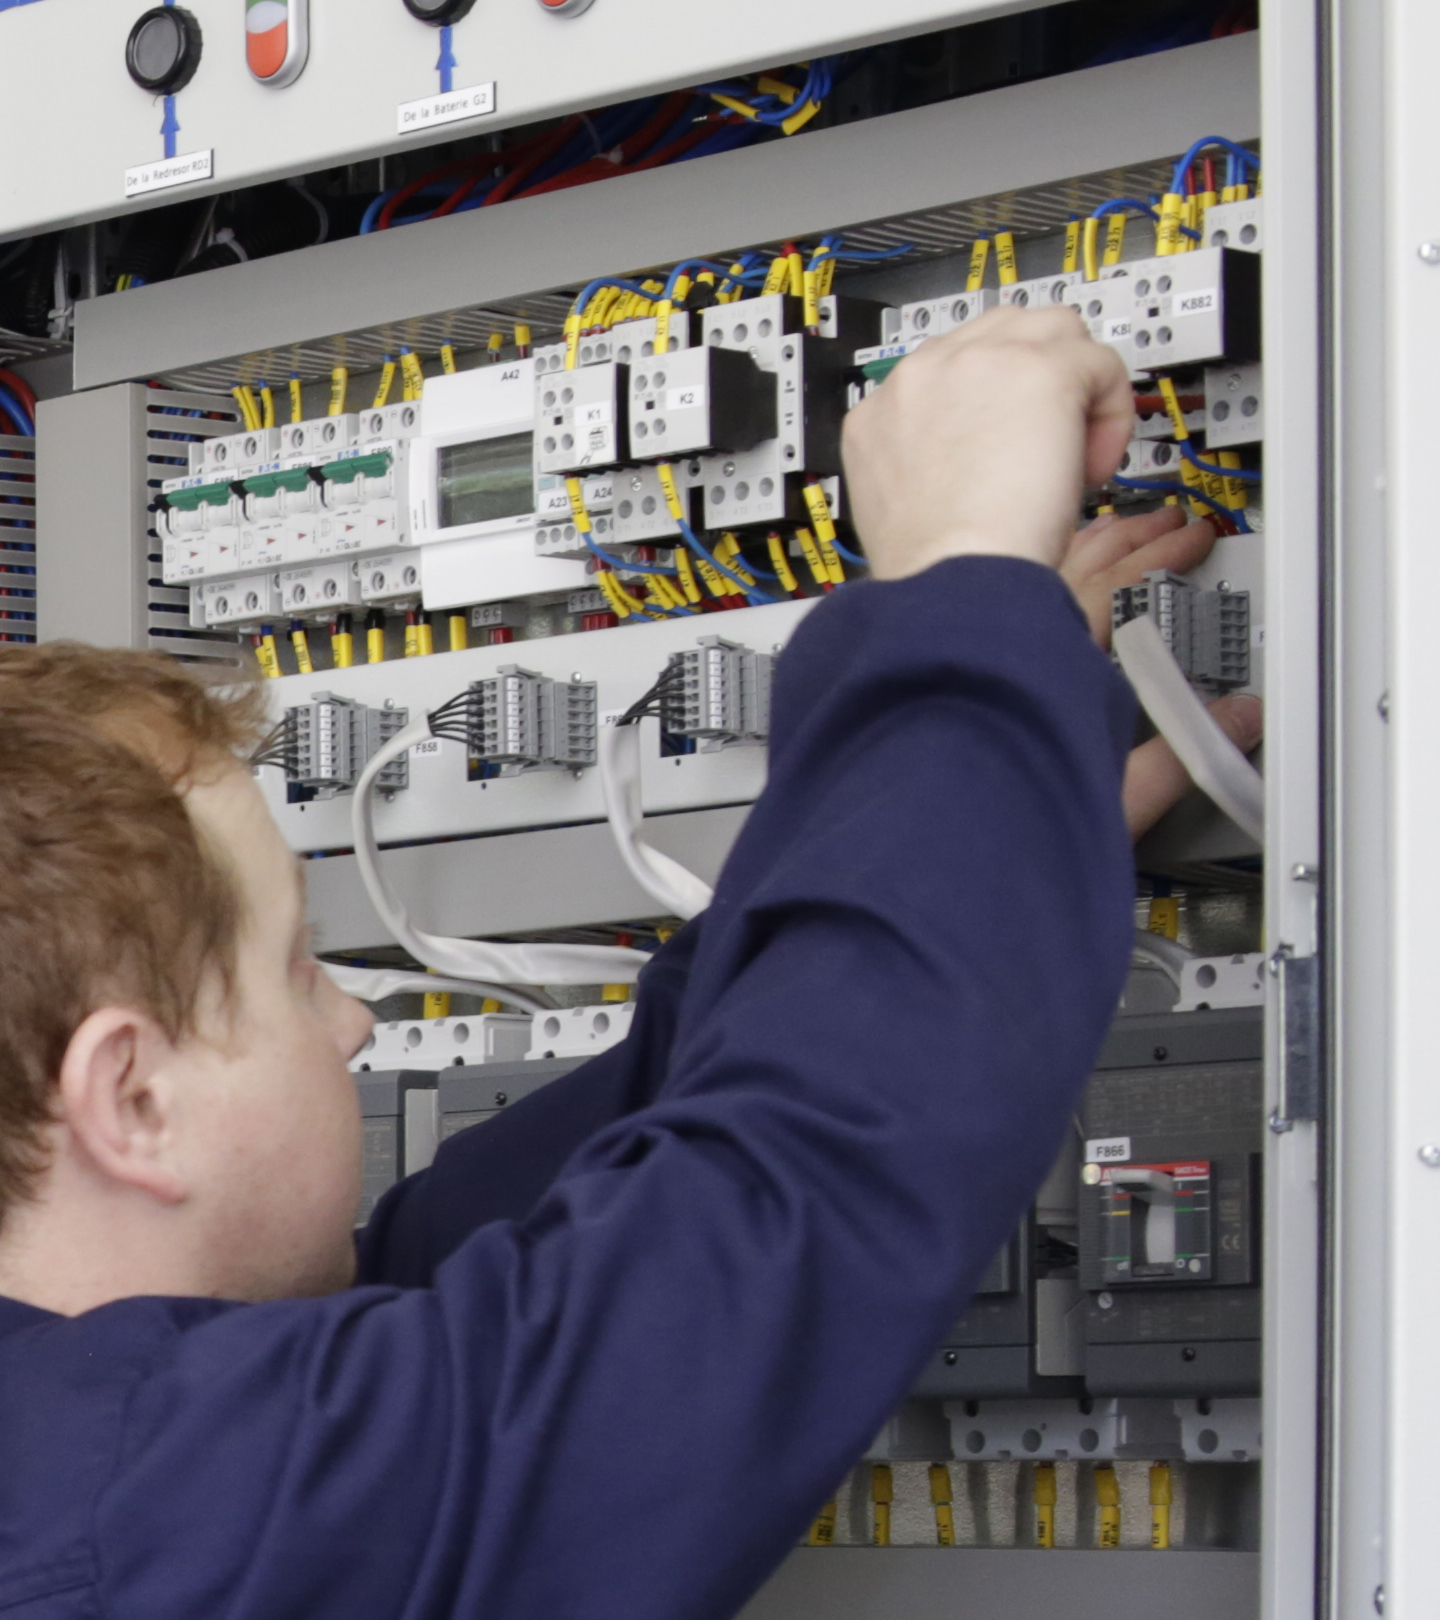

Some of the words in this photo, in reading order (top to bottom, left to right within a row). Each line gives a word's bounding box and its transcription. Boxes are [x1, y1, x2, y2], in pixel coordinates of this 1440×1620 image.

[403, 111, 416, 123] De
[421, 107, 429, 118] la
[434, 98, 469, 115] Baterie
[473, 93, 487, 105] G2
[127, 176, 138, 187] De
[1181, 295, 1212, 310] K882
[501, 369, 520, 382] A42
[680, 393, 694, 404] K2
[588, 409, 601, 420] K1
[548, 496, 567, 509] A23
[416, 742, 438, 754] F858
[1096, 1144, 1125, 1157] F866
